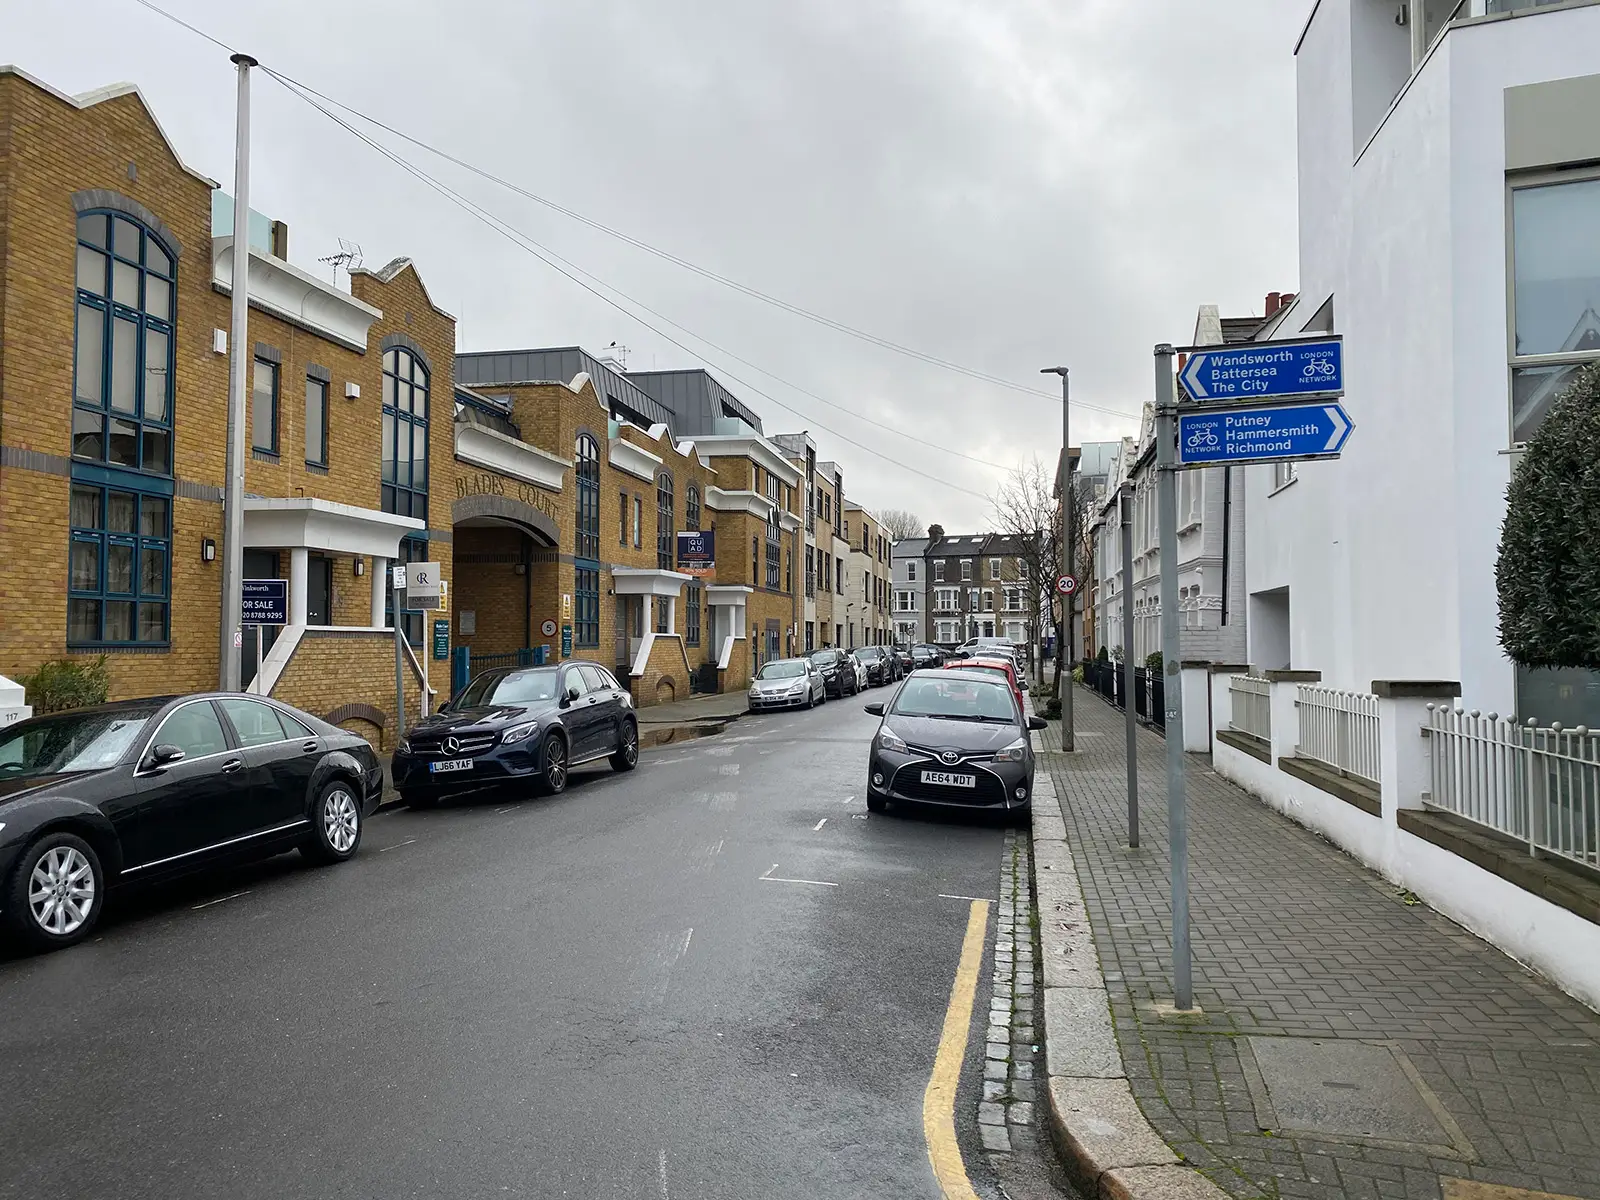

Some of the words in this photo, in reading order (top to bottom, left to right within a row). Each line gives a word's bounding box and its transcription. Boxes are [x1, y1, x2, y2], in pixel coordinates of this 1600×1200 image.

[1211, 351, 1293, 367] Wandsworth
[1300, 350, 1334, 360] LONDON
[1211, 366, 1277, 380] Battersea
[1299, 374, 1337, 384] NETWORK
[1212, 381, 1235, 393] The
[1241, 379, 1269, 392] City
[1186, 421, 1219, 430] LONDON
[1225, 415, 1271, 428] Putney
[1225, 424, 1319, 441] Hammersmith
[1185, 445, 1222, 454] NETWORK
[1226, 440, 1292, 454] Richmond
[455, 474, 505, 499] BLADES
[518, 484, 559, 521] COURT
[1060, 580, 1073, 588] 20
[242, 600, 253, 609] OR
[254, 600, 274, 609] SALE
[546, 624, 552, 632] 5
[6, 713, 18, 721] 117
[434, 761, 454, 771] LJ66
[456, 760, 471, 769] YAF
[925, 772, 950, 783] AE64
